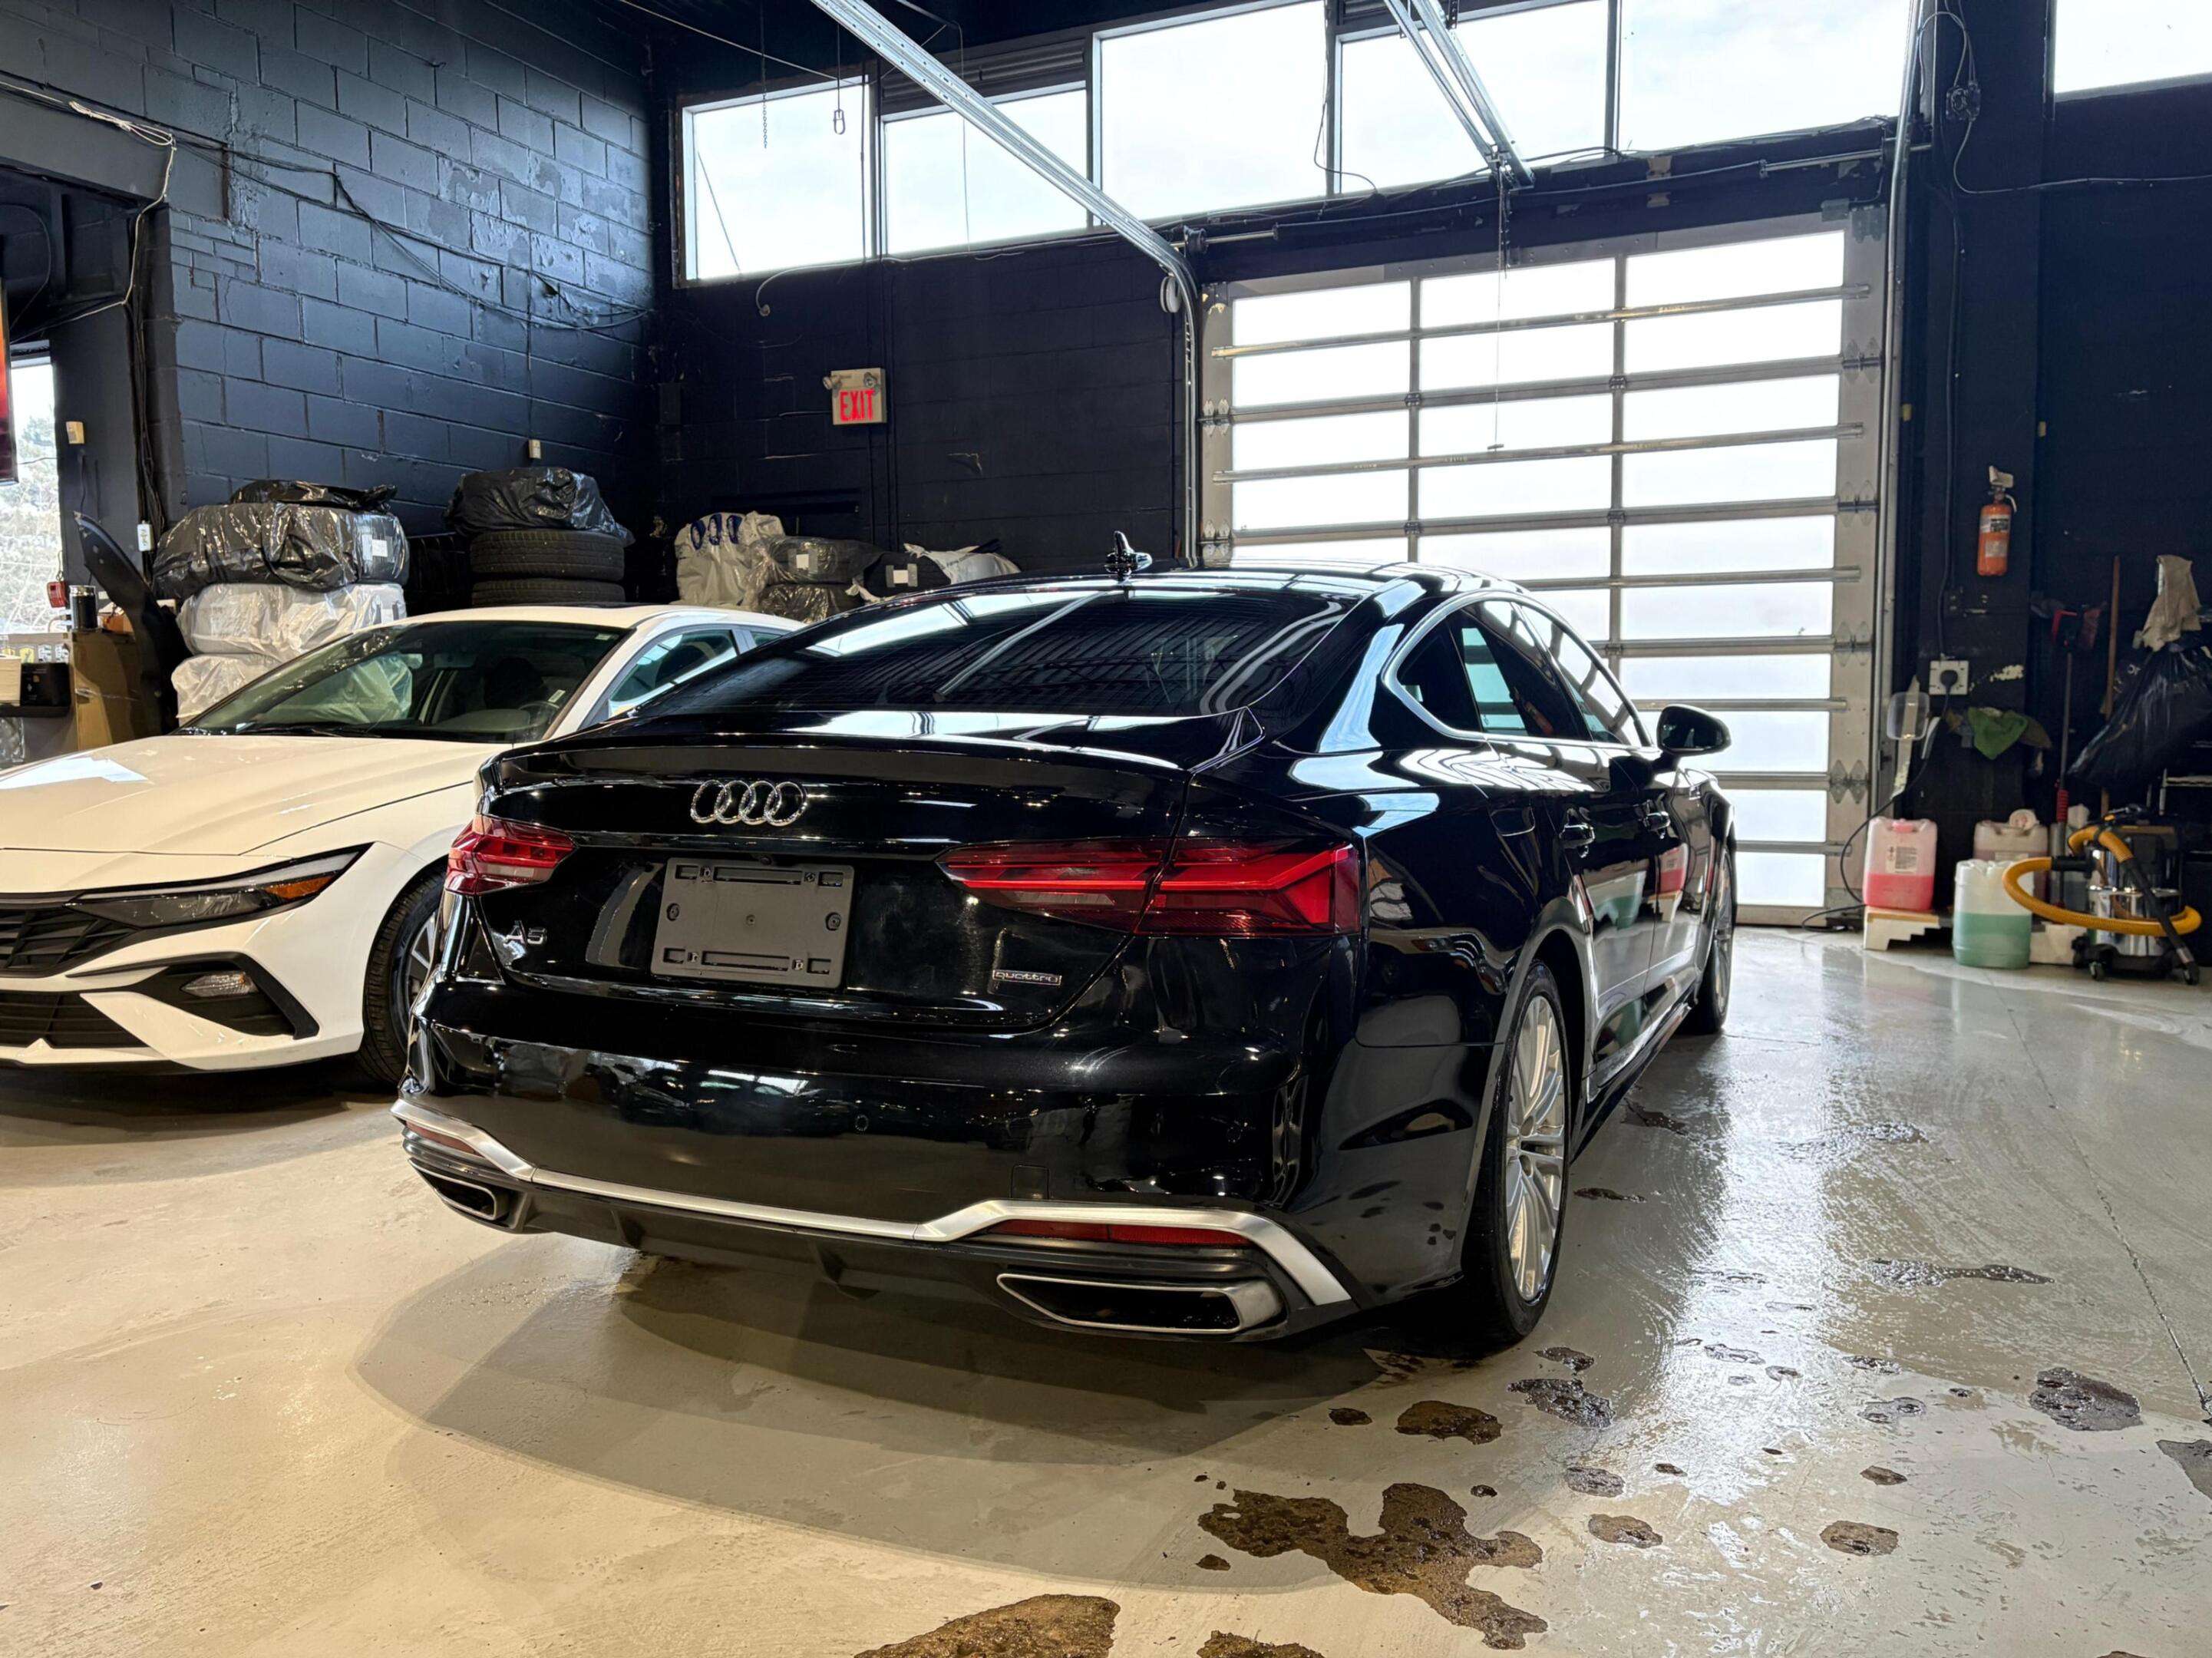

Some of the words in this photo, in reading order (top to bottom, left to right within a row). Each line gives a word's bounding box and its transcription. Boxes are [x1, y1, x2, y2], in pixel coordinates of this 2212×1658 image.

[840, 389, 875, 422] EXIT
[505, 920, 546, 946] A5
[995, 970, 1059, 983] quattro
